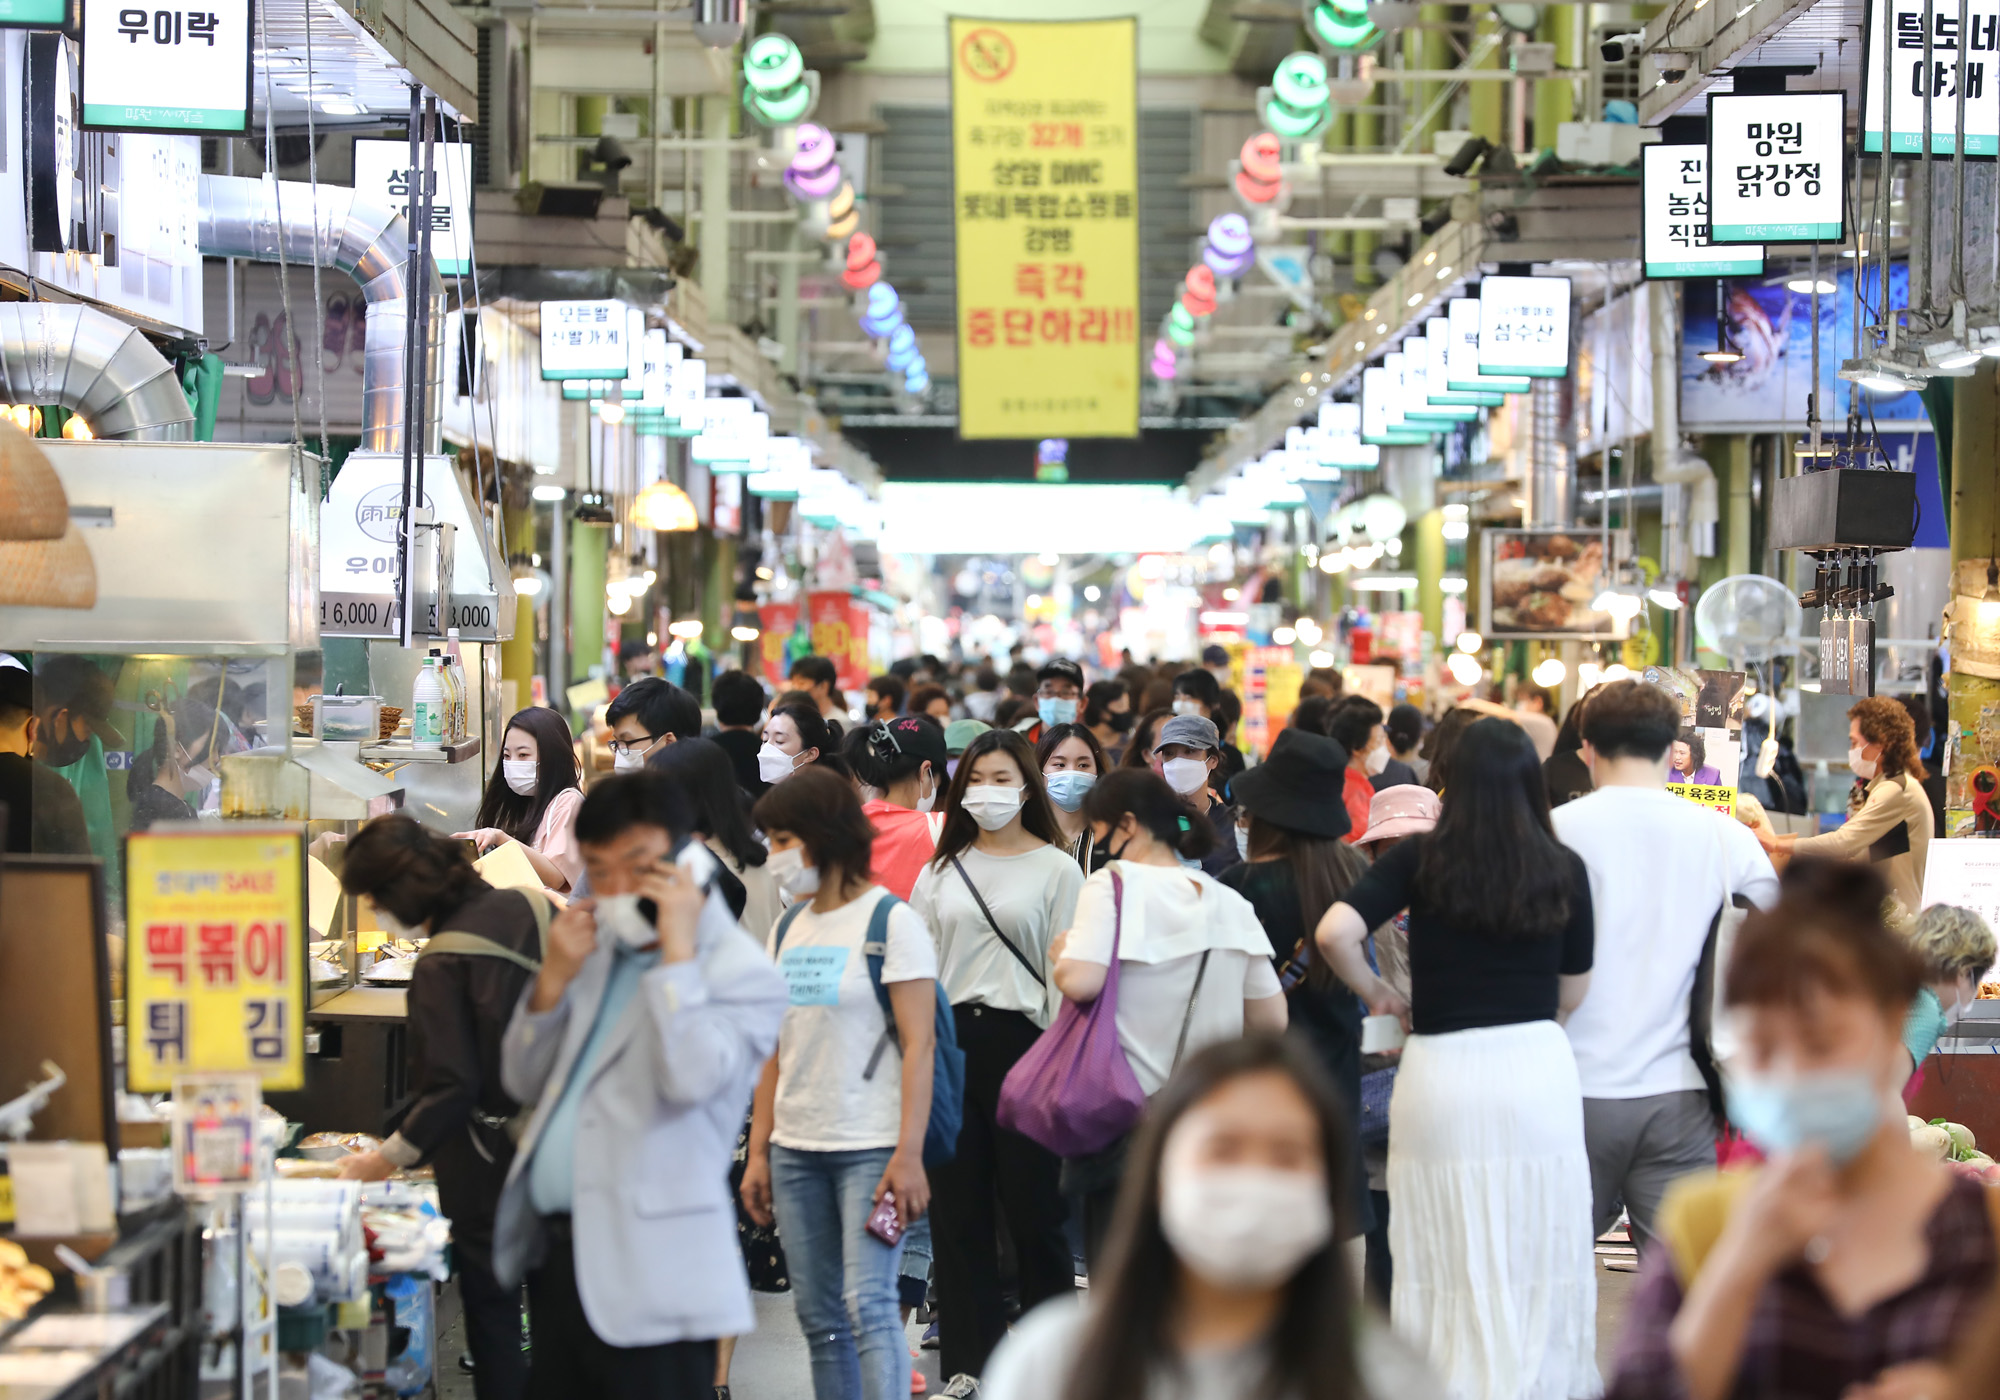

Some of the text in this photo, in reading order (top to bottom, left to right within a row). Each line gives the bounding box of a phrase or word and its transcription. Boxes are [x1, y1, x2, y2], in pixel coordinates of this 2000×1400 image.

[118, 9, 220, 46] 우이락
[1897, 12, 2000, 51] 털보네
[1912, 60, 1984, 99] 야채
[1747, 121, 1803, 157] 망원
[1736, 162, 1822, 198] 닭강정
[1015, 263, 1087, 300] 즉각
[967, 307, 1135, 348] 중단하라!!
[333, 602, 377, 627] 6,000
[1688, 787, 1732, 803] 육중완
[145, 920, 288, 986] 떡볶이
